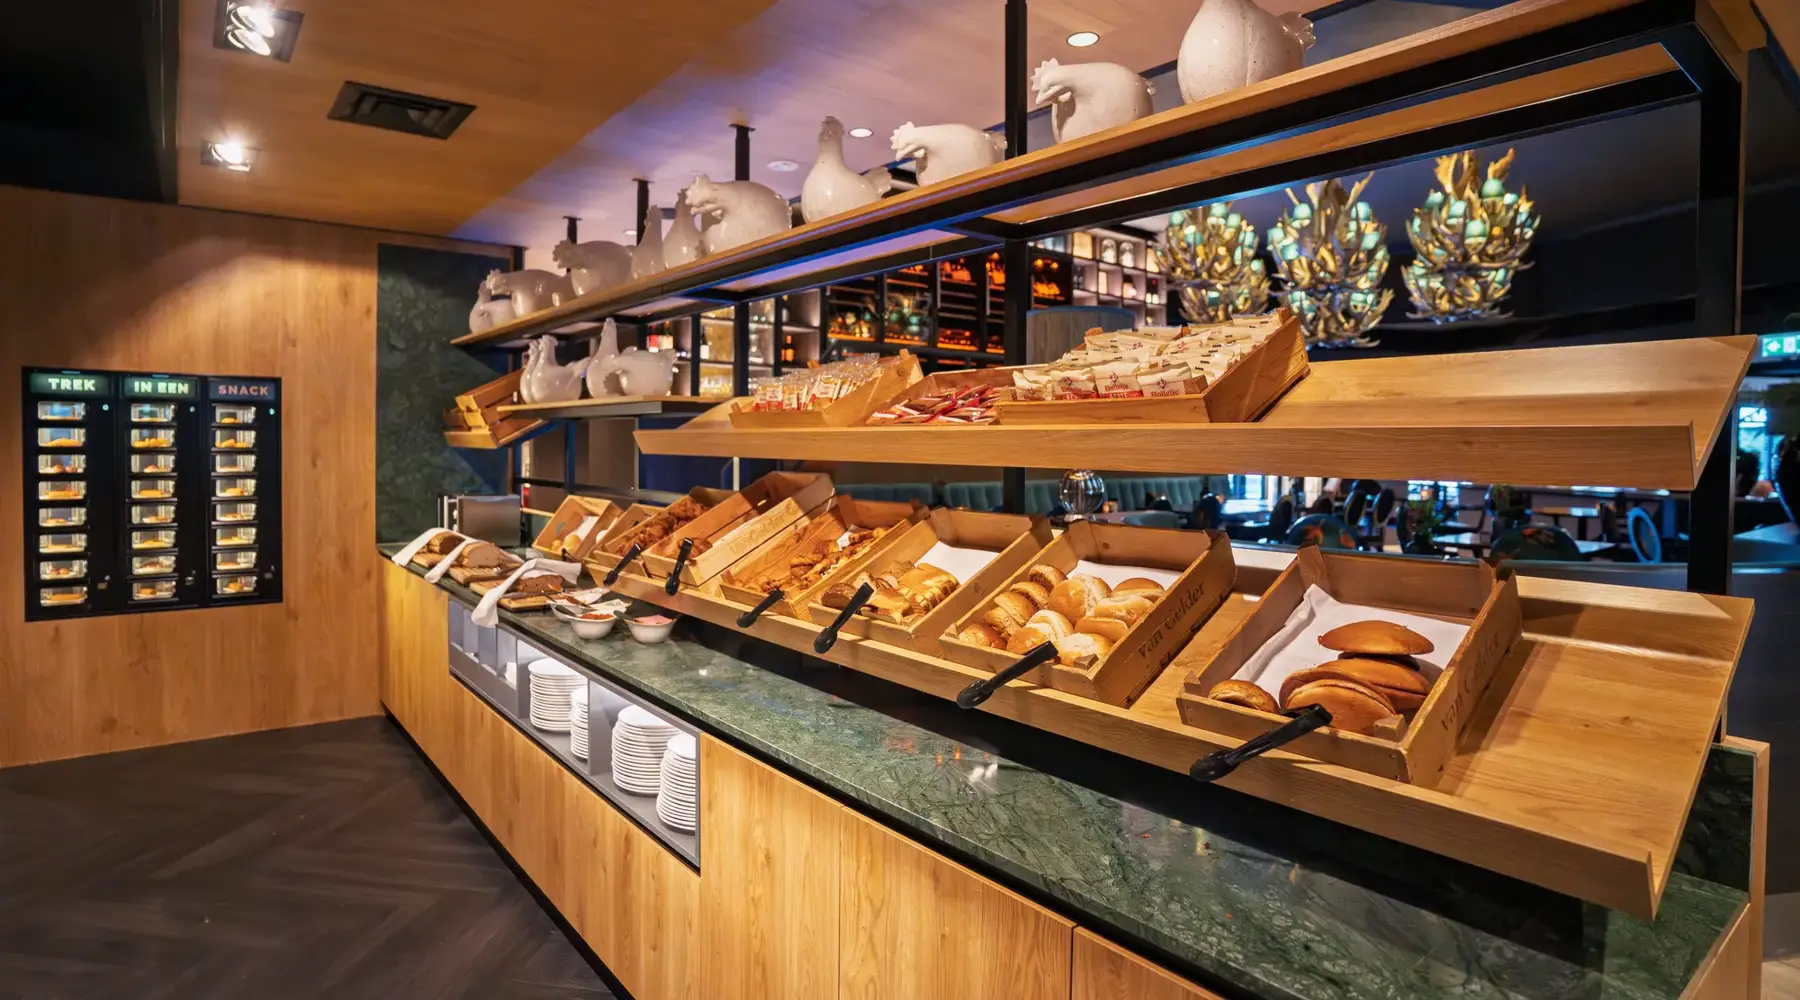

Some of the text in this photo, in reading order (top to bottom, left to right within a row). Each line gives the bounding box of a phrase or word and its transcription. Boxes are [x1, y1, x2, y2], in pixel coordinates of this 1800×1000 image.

[48, 377, 269, 396] TREK IN EEN SNACK
[1164, 581, 1205, 630] Gelder
